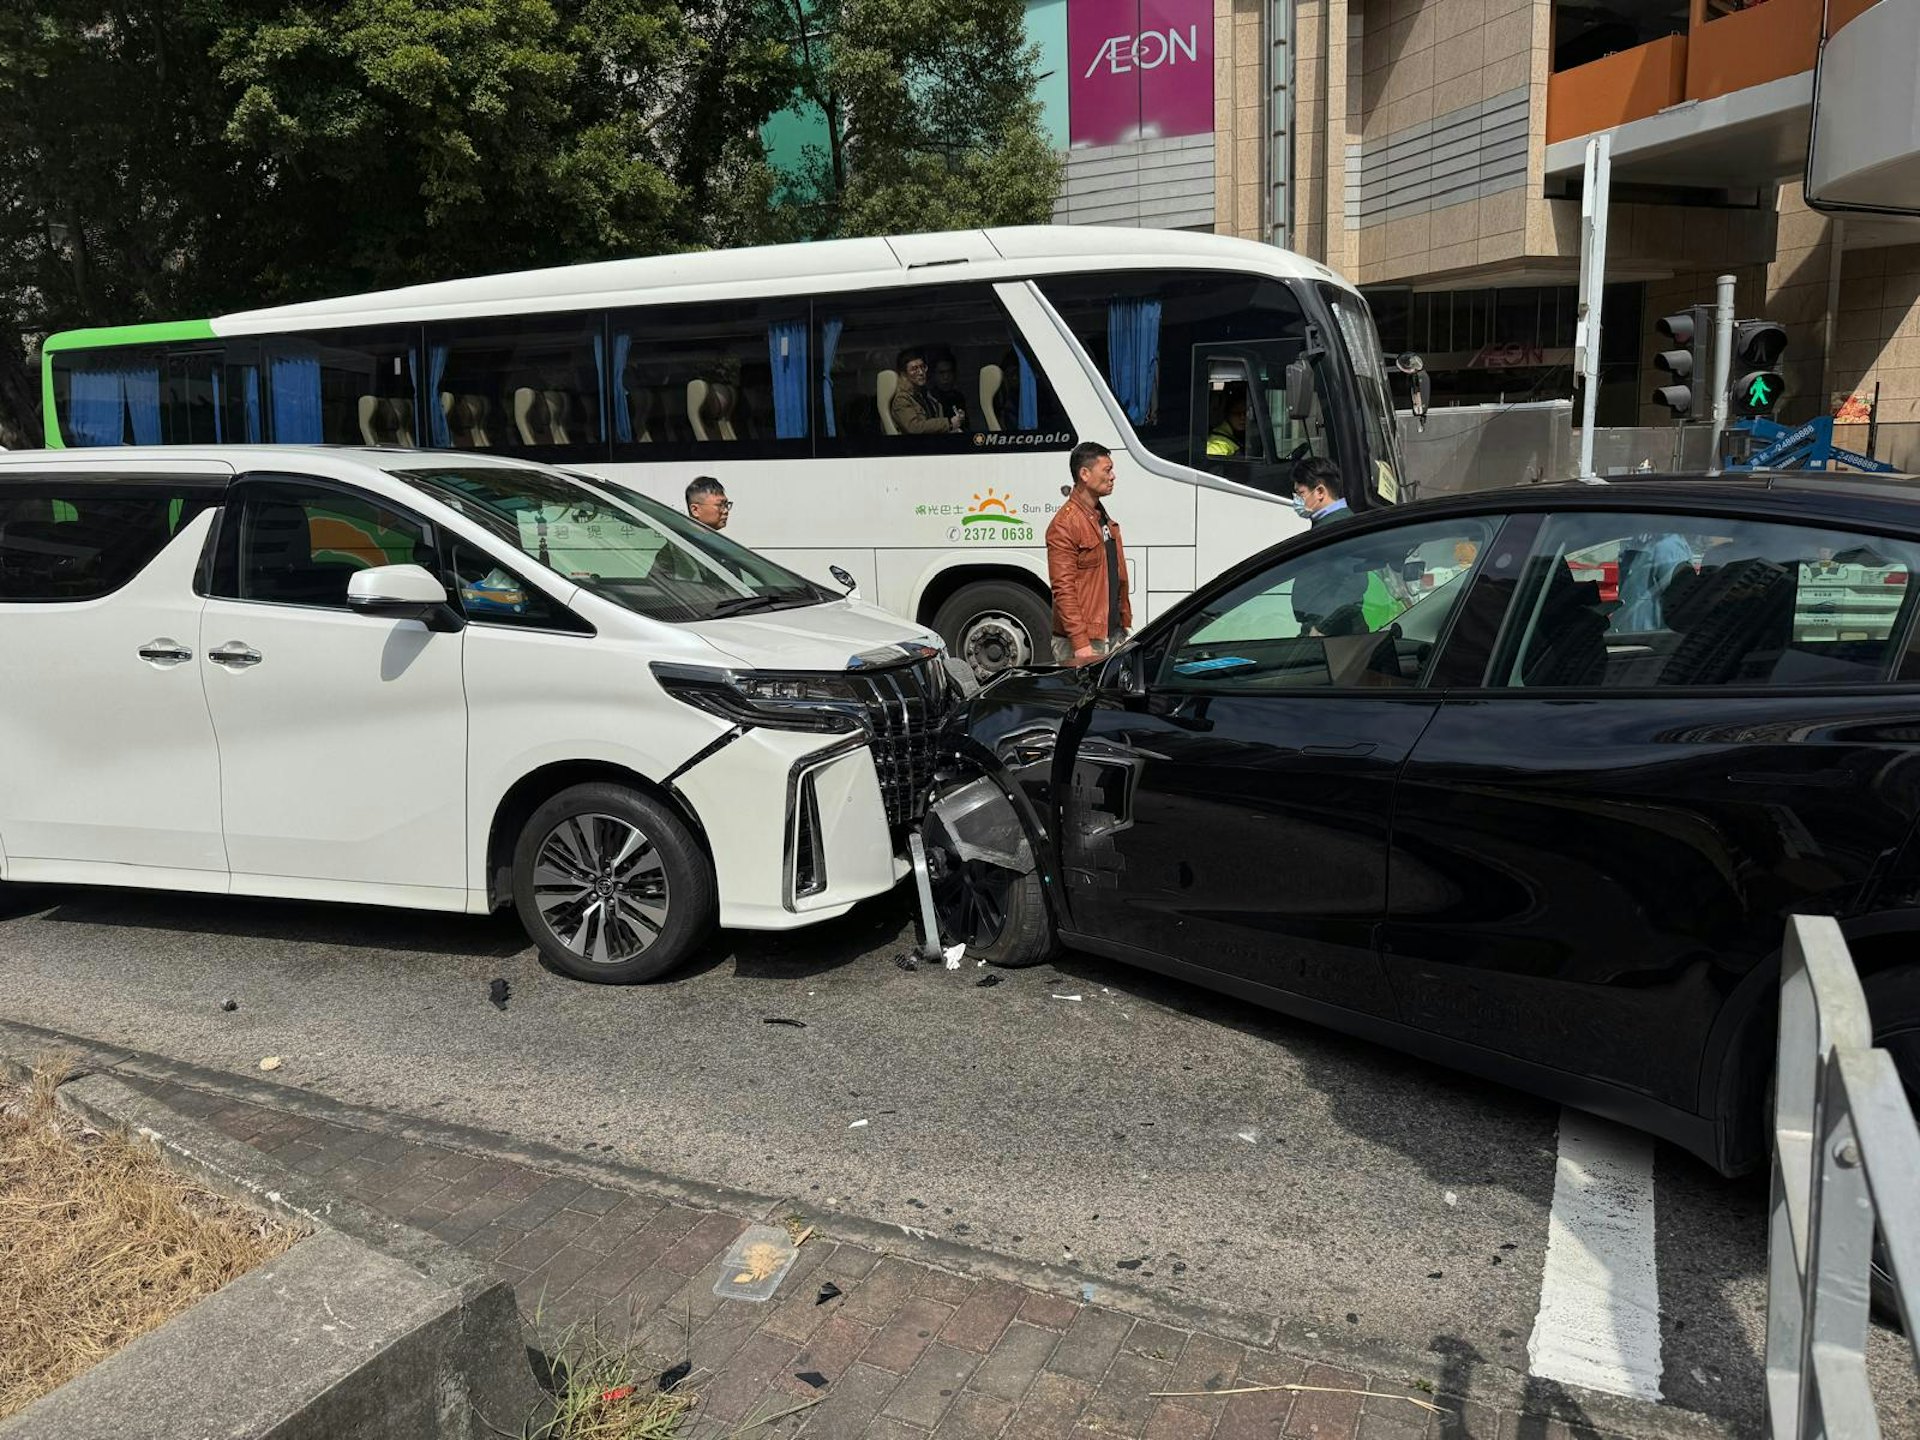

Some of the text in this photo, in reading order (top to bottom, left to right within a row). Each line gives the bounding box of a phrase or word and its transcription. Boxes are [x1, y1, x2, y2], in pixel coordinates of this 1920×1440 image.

[985, 431, 1071, 446] Marcopolo
[1022, 503, 1041, 513] Sun
[964, 527, 1033, 541] 2372 0638
